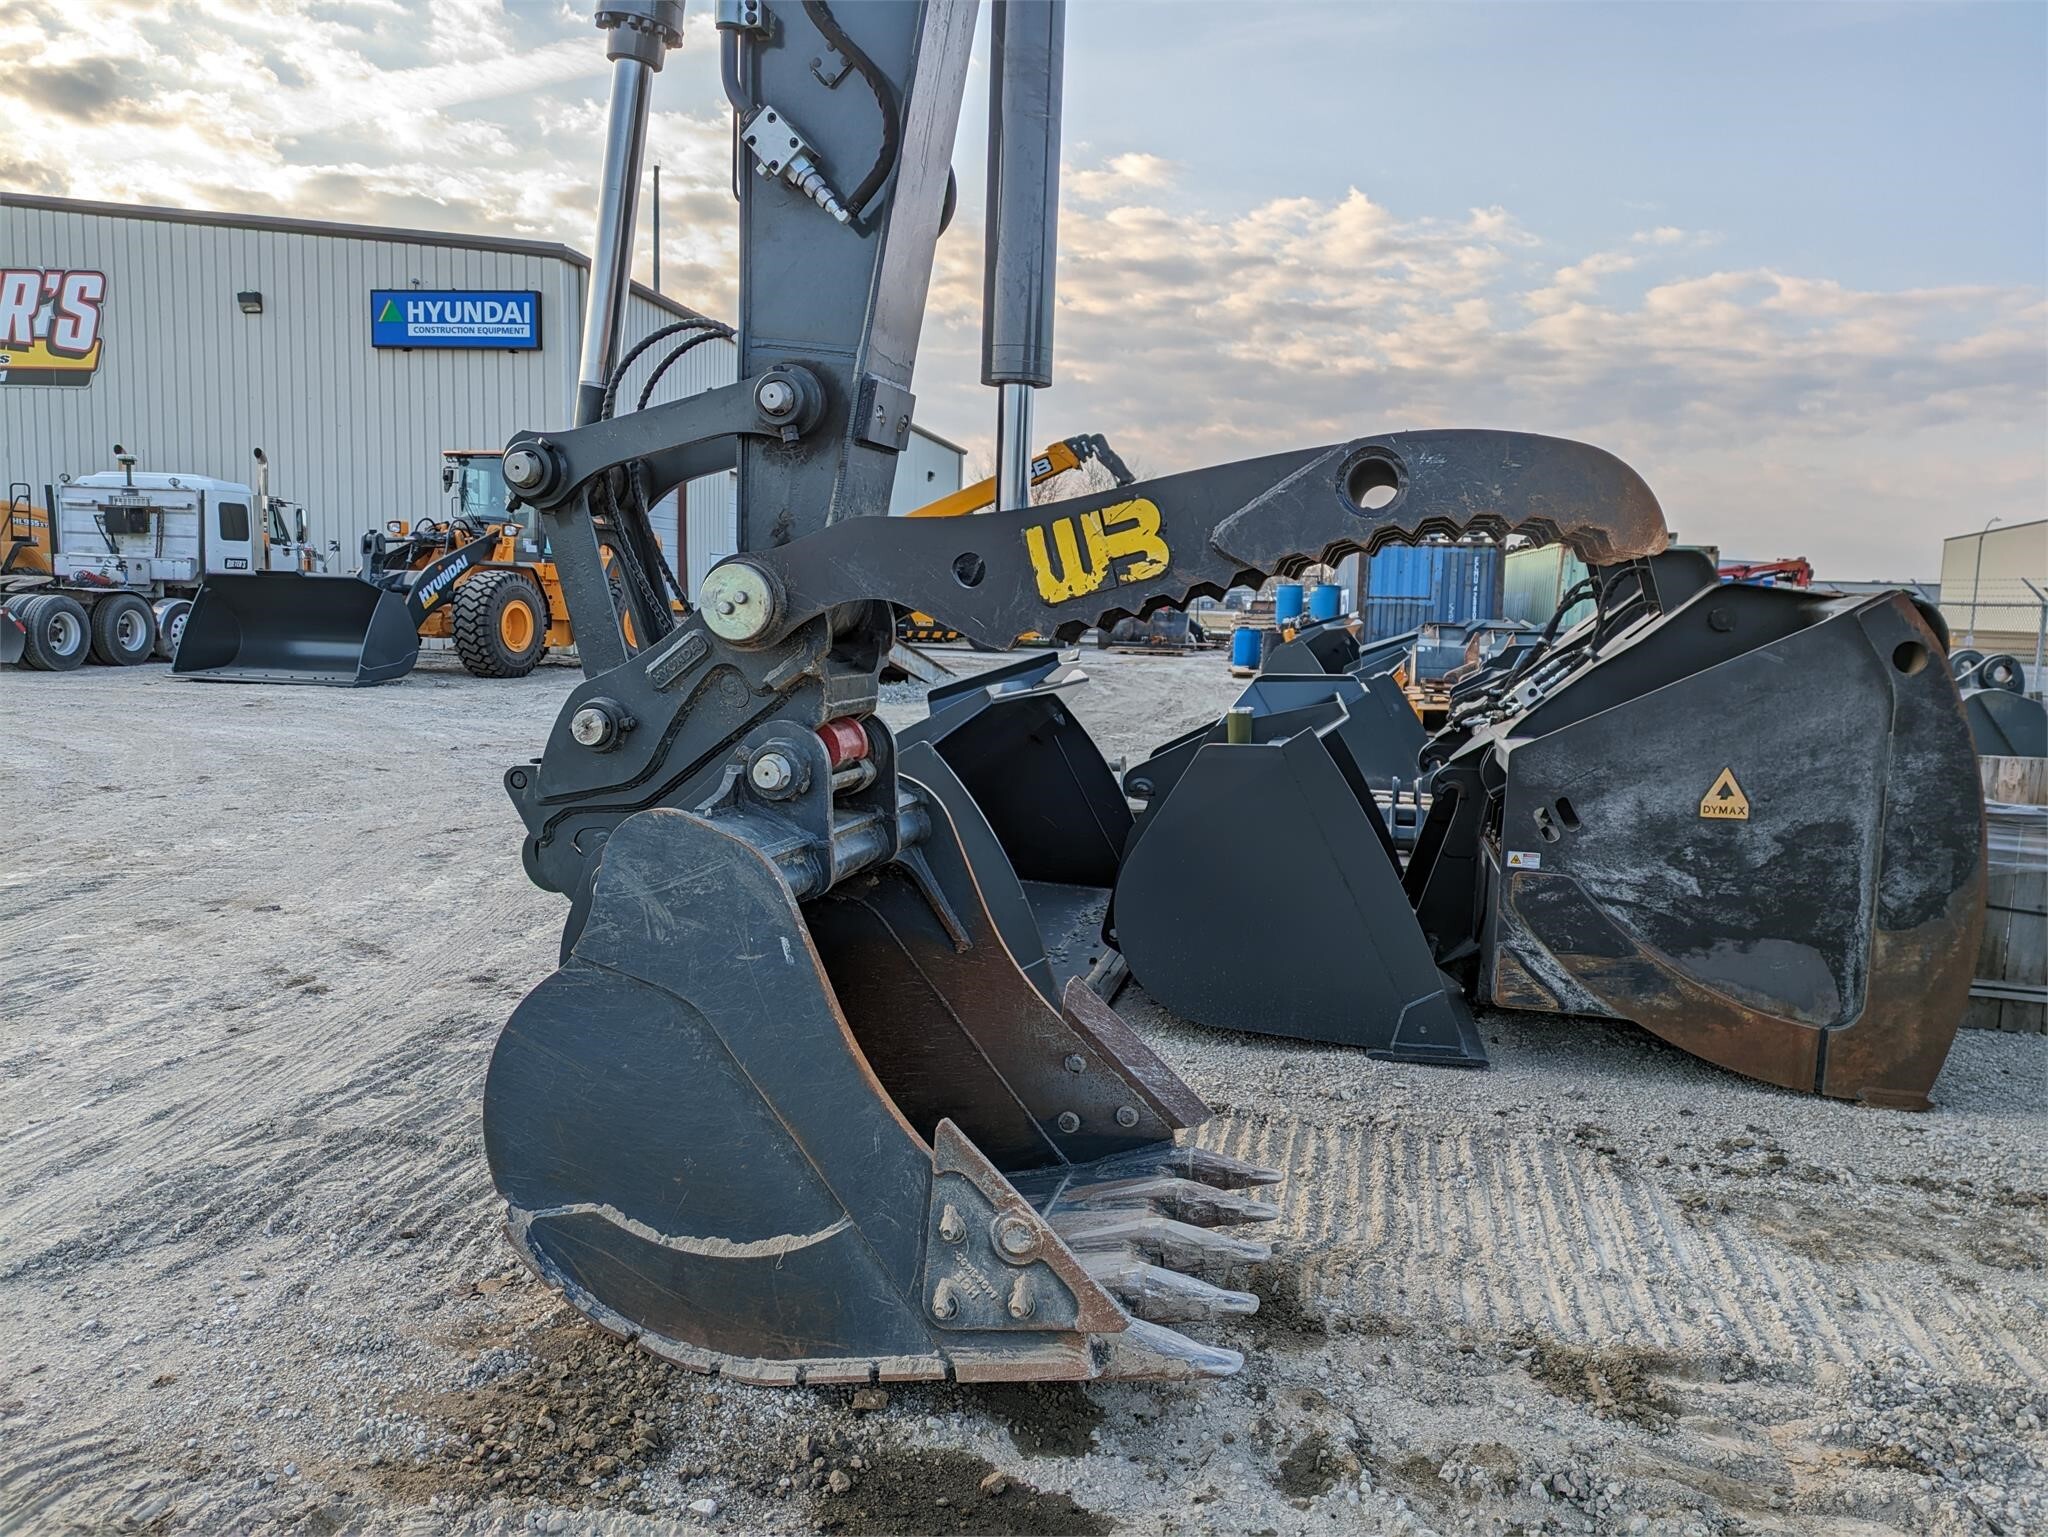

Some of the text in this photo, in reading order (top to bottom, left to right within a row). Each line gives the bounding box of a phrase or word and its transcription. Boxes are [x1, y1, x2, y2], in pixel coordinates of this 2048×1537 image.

[407, 301, 530, 324] HYUNDAI
[413, 326, 525, 335] CONSTRUCTION EQUIPMENT
[1026, 498, 1170, 604] WB
[418, 554, 469, 604] HYUNDAI
[652, 636, 705, 684] HYUNDAI
[1703, 805, 1746, 816] DYMAX
